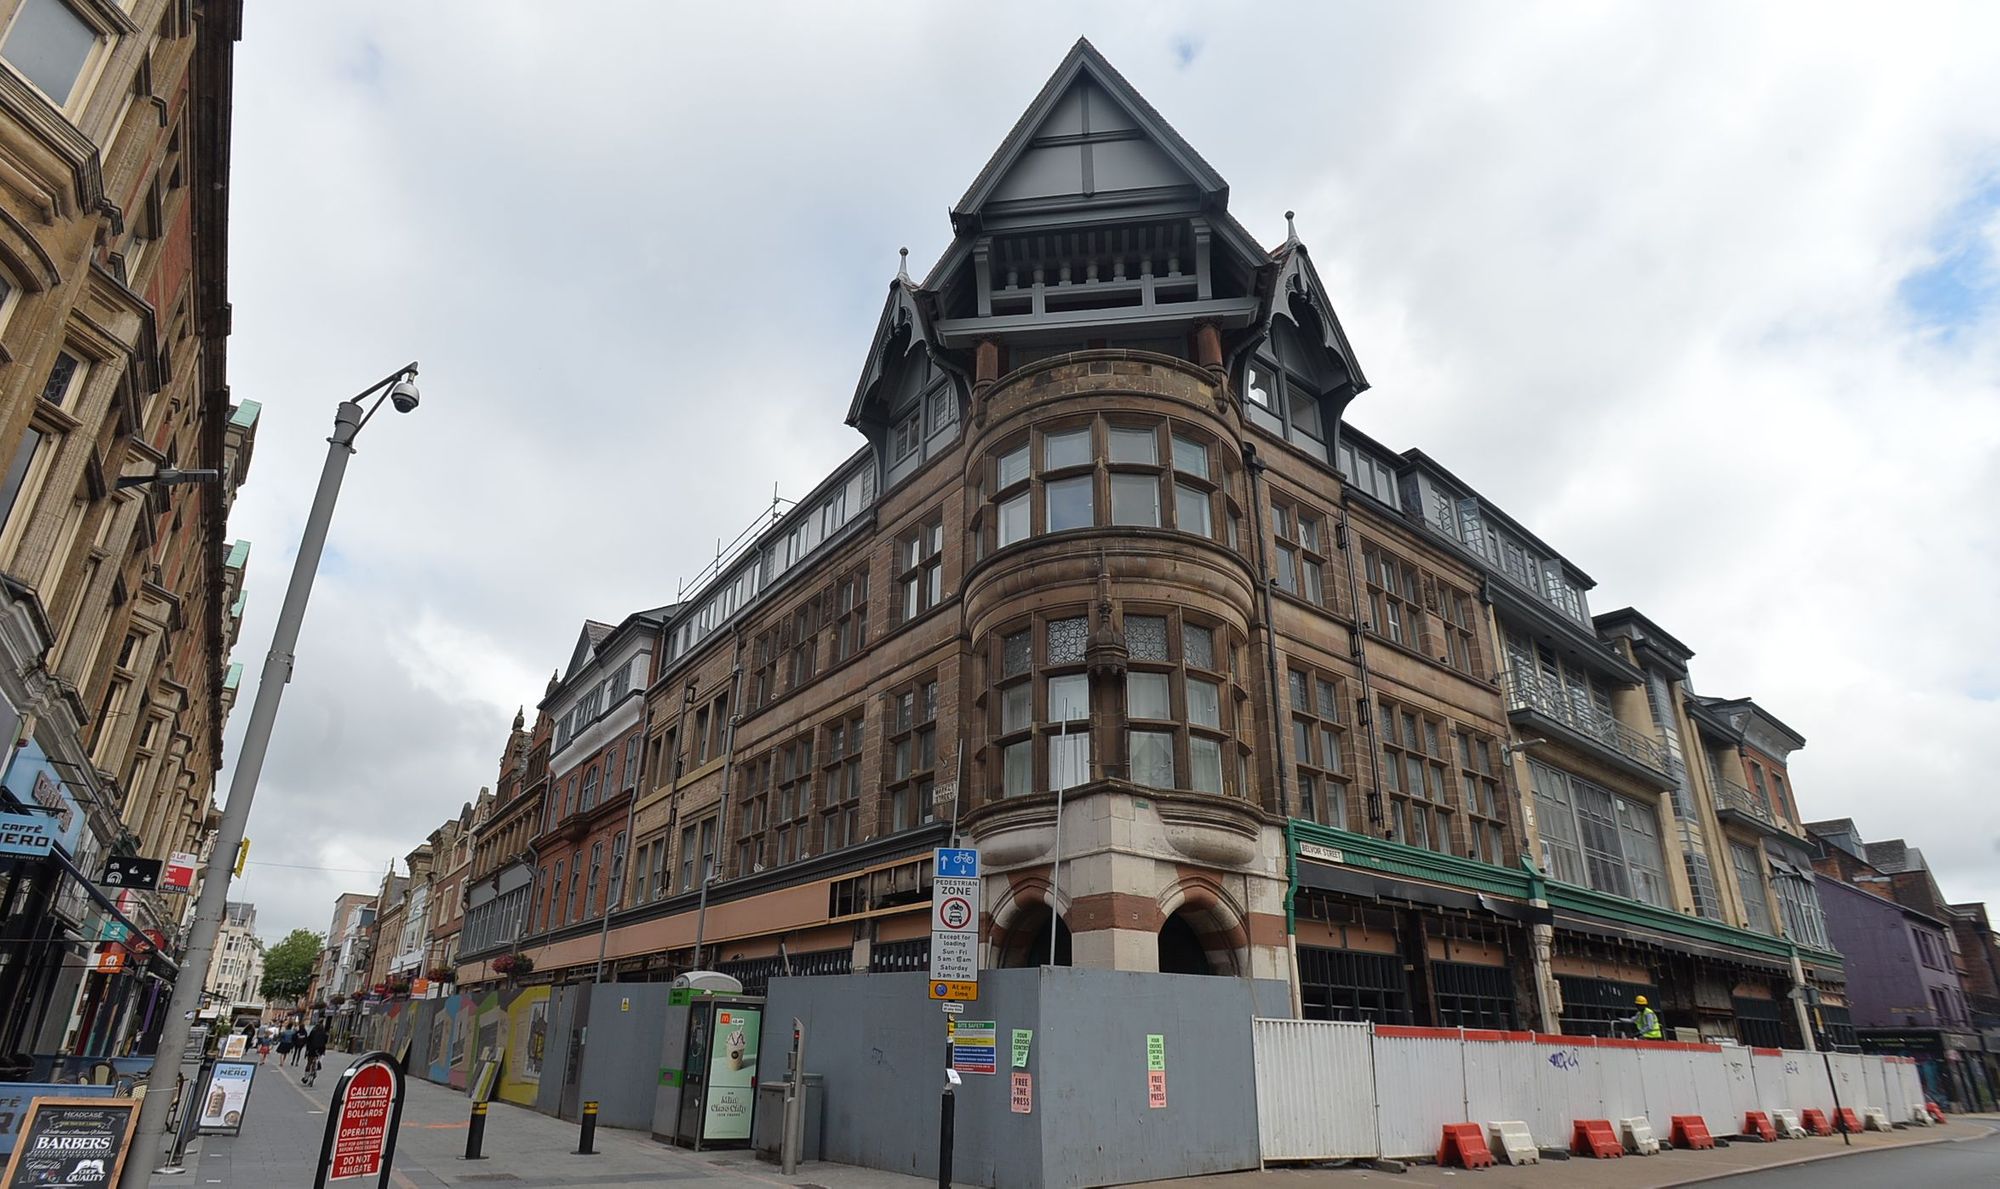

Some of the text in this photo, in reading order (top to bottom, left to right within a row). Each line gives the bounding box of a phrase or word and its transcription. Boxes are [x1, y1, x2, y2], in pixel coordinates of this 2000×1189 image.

[0, 833, 49, 847] ERO
[1323, 849, 1341, 859] STREET
[942, 887, 971, 895] ZONE
[1015, 1078, 1028, 1086] FREE
[351, 1087, 389, 1096] CAUTION
[1016, 1088, 1026, 1096] THE
[1013, 1097, 1029, 1106] PRESS
[1151, 1093, 1164, 1101] PRESS
[347, 1100, 387, 1109] AUTOMATIC
[347, 1109, 383, 1118] BOLLARDS
[342, 1127, 382, 1137] OPERATION
[36, 1136, 111, 1149] BARBERS
[343, 1155, 371, 1165] DO NOT
[339, 1163, 372, 1175] TAILGATE
[66, 1174, 106, 1183] QUALITY
